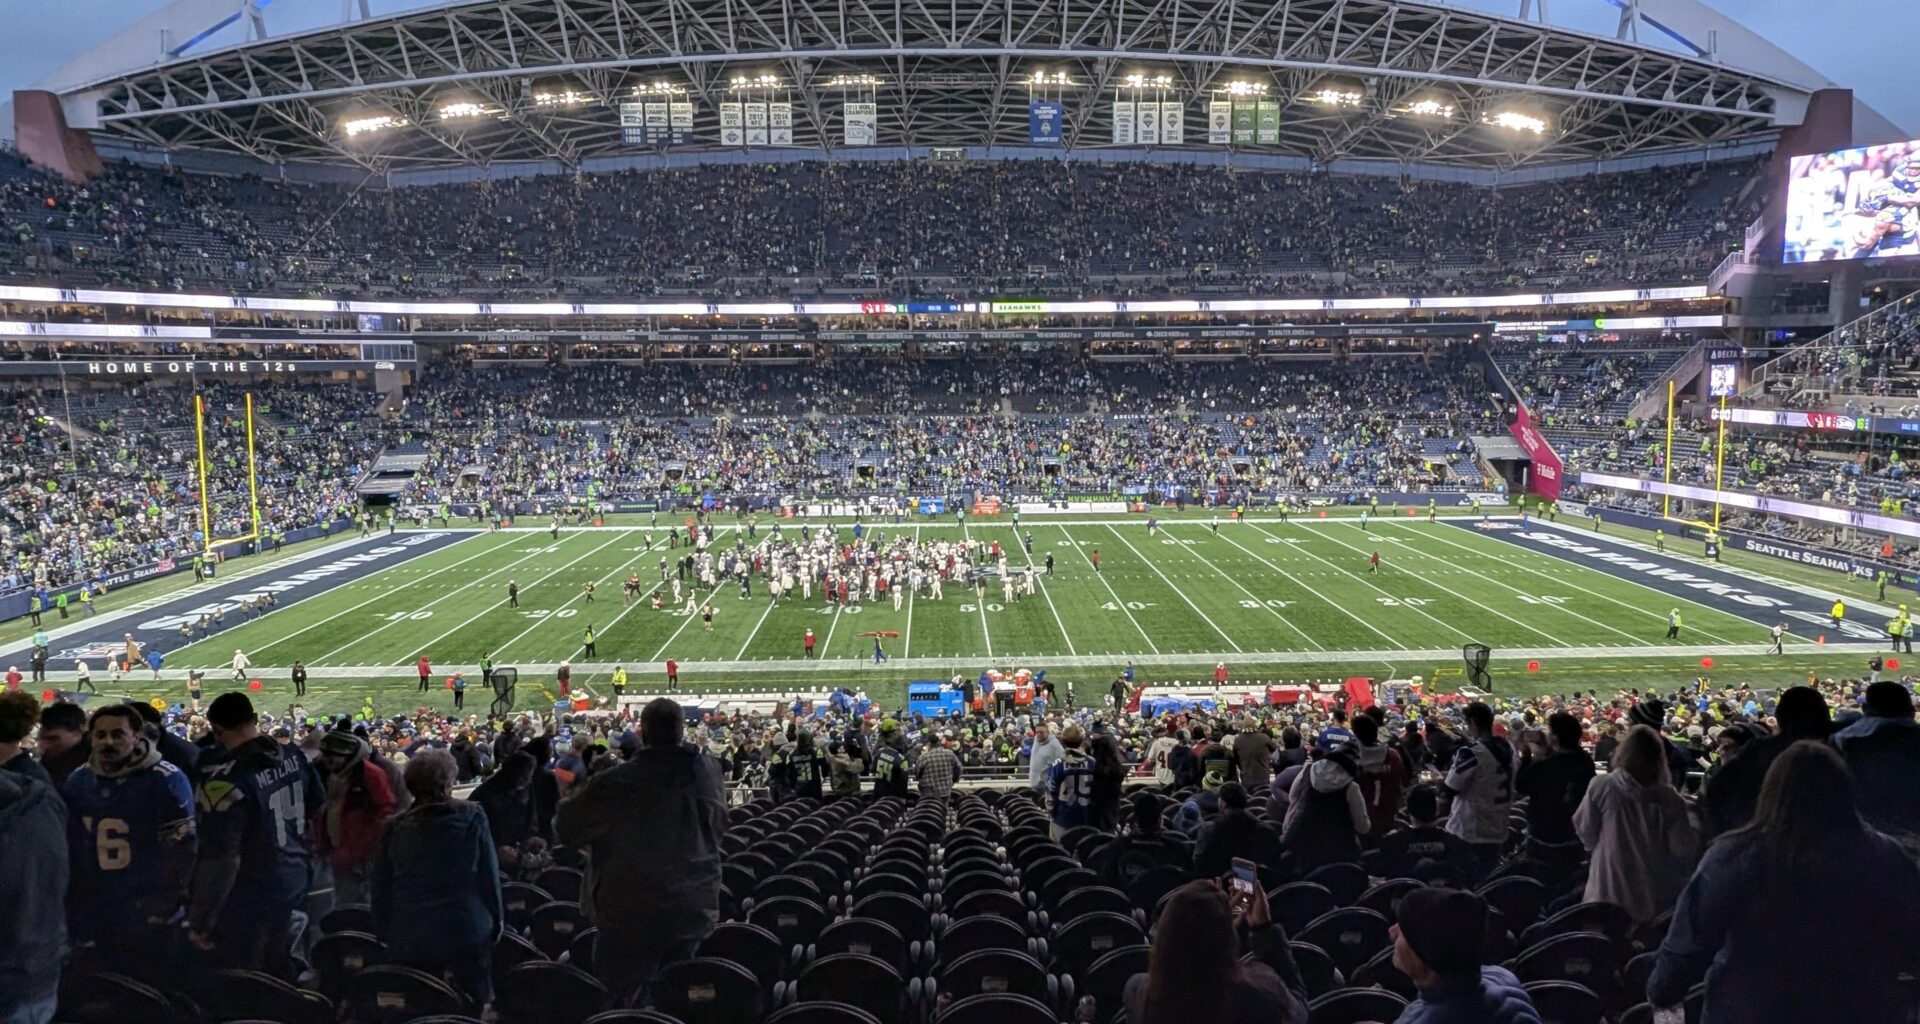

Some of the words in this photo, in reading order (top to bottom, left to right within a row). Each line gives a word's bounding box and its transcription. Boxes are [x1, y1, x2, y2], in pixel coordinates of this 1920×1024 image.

[59, 288, 77, 302] WIN
[1637, 289, 1650, 299] WIN
[479, 304, 491, 314] WIN
[572, 304, 584, 314] WIN
[1663, 317, 1677, 327] WIN
[29, 323, 46, 334] WIN
[143, 326, 157, 336] WIN
[89, 362, 152, 374] HOME
[169, 362, 194, 372] OF
[209, 362, 247, 372] THE
[262, 362, 295, 371] 12s
[1857, 418, 1864, 429] 16
[1850, 511, 1864, 526] WIN
[1746, 539, 1800, 561] SEATTLE
[1510, 532, 1792, 607] SEAHAWKS
[92, 574, 130, 589] SATTLE
[137, 546, 407, 630] SEAHAWKS
[1239, 600, 1287, 608] 30
[1376, 597, 1426, 606] 20
[1516, 595, 1564, 604] 10
[815, 605, 862, 614] 40
[960, 603, 1004, 613] 50
[1100, 601, 1146, 611] 40
[384, 611, 433, 620] 10
[526, 609, 577, 618] 20
[152, 760, 178, 776] 16
[255, 755, 300, 787] METCALF
[1059, 774, 1094, 806] 45
[268, 780, 305, 847] 14
[82, 816, 132, 870] 6
